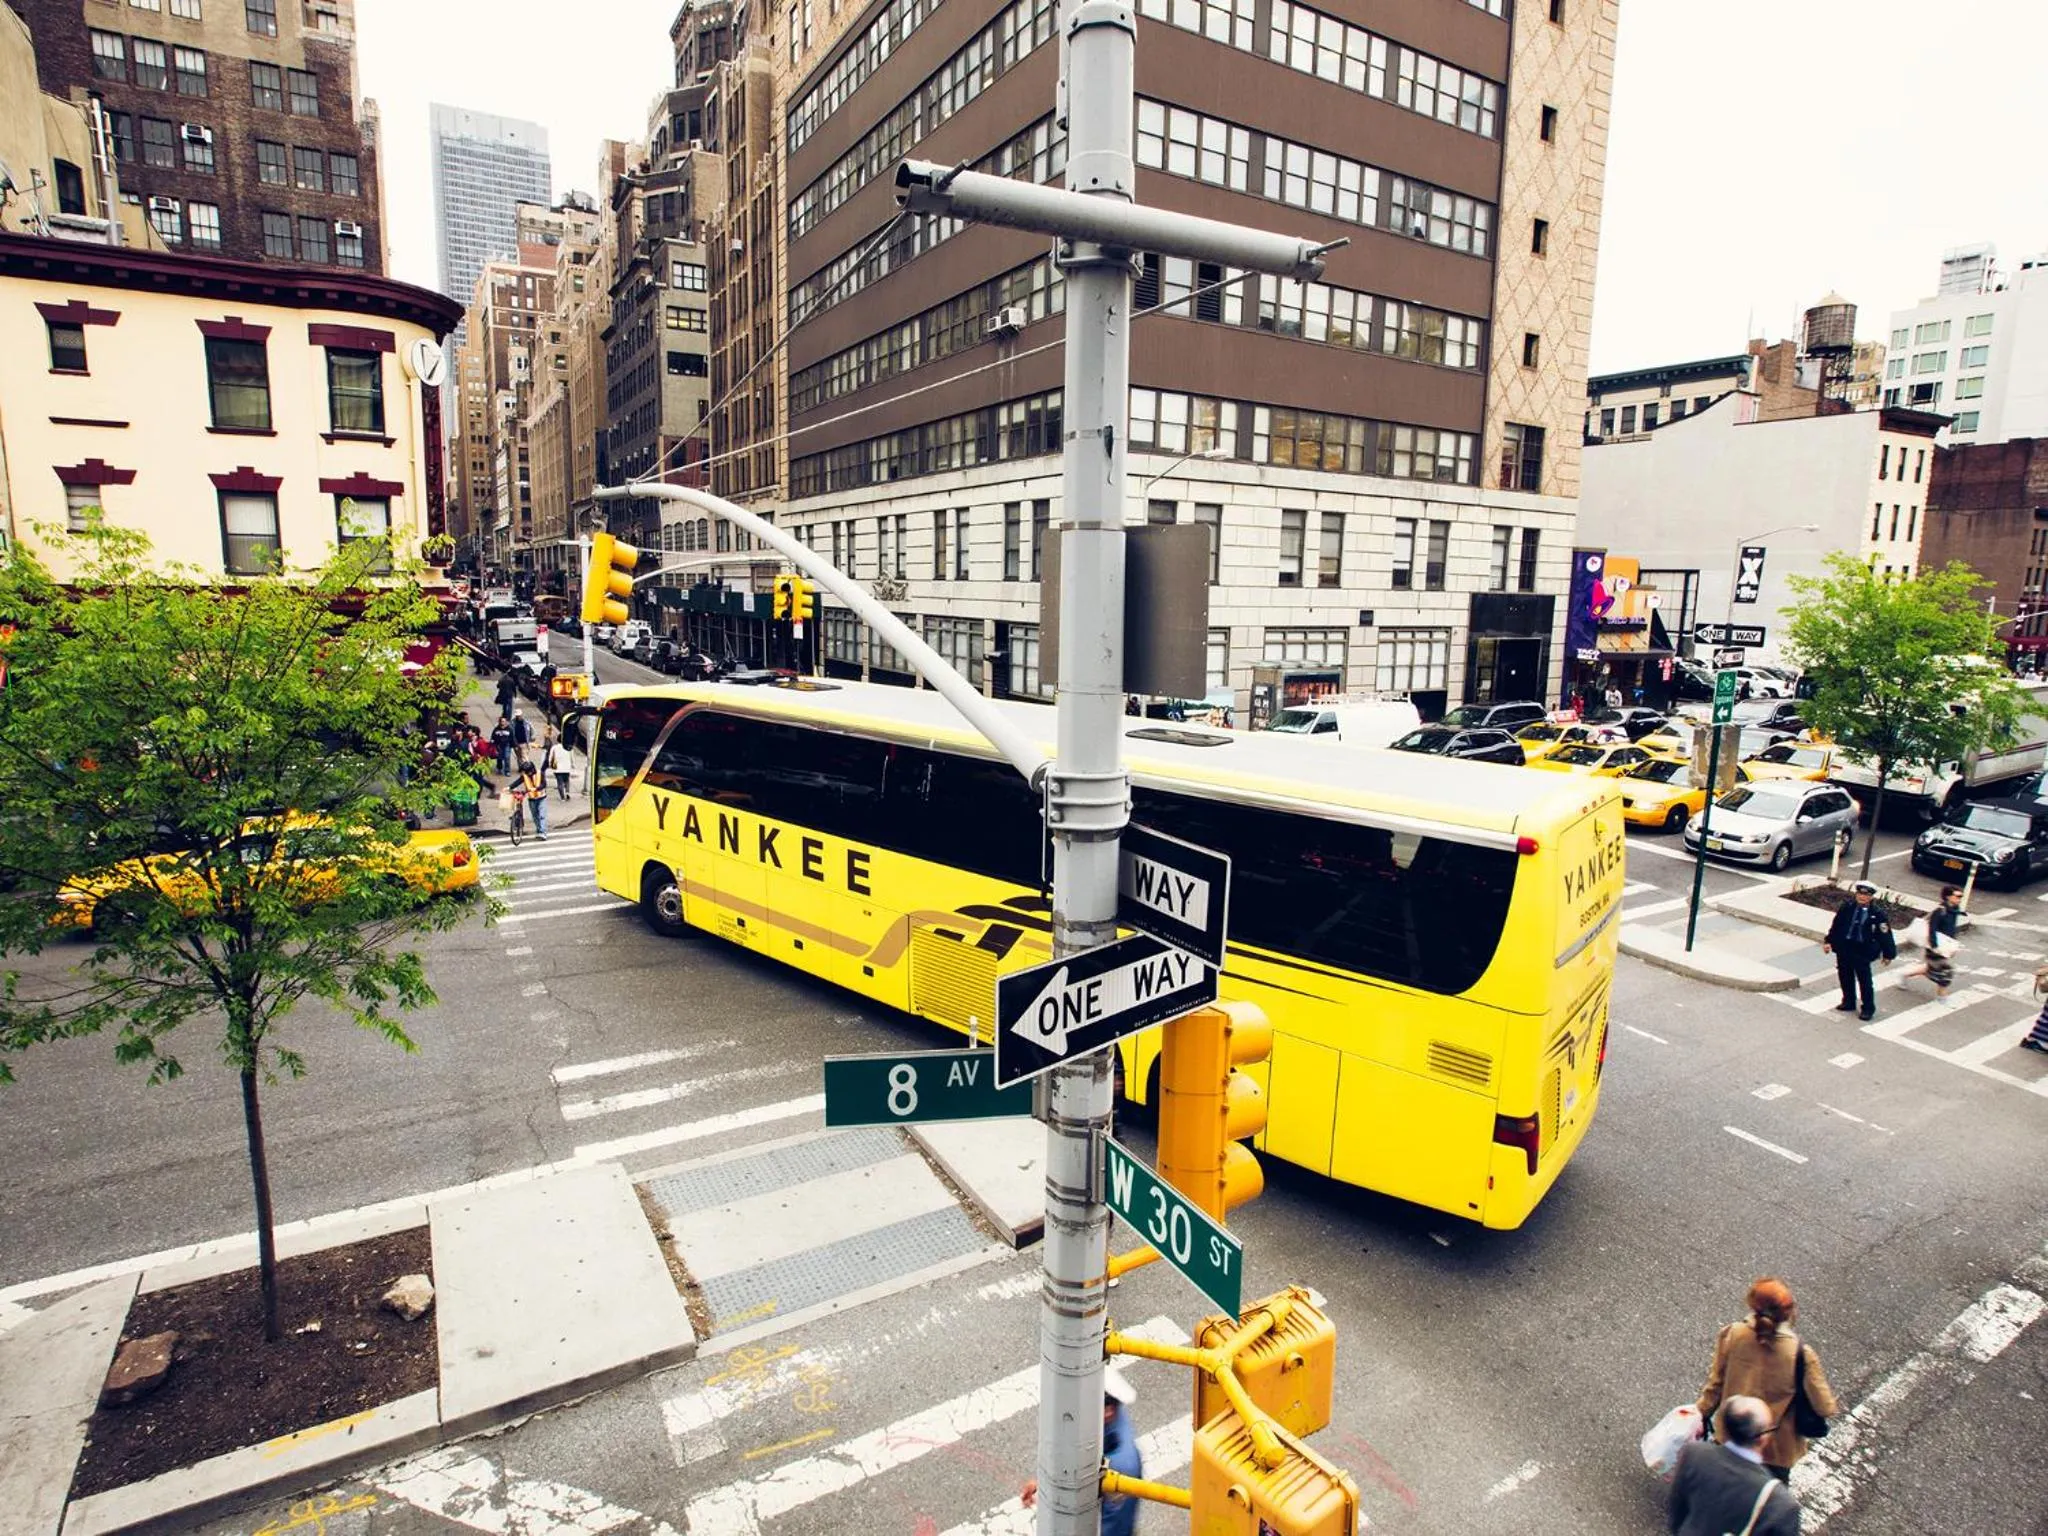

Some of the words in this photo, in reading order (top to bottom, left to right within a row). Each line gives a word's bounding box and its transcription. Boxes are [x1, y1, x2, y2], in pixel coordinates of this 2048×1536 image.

[1701, 630, 1724, 639] ONE
[1735, 631, 1758, 640] WAY
[652, 793, 871, 897] YANKEE
[1564, 834, 1621, 905] YANKEE
[1135, 860, 1196, 917] WAY
[1038, 980, 1103, 1036] ONE
[1134, 953, 1191, 1001] WAY
[1165, 995, 1210, 1015] TRANSPORTATION
[887, 1063, 919, 1116] 8
[946, 1060, 980, 1088] AV
[1109, 1150, 1136, 1214] W
[1147, 1185, 1192, 1266] 30
[1208, 1235, 1233, 1276] ST
